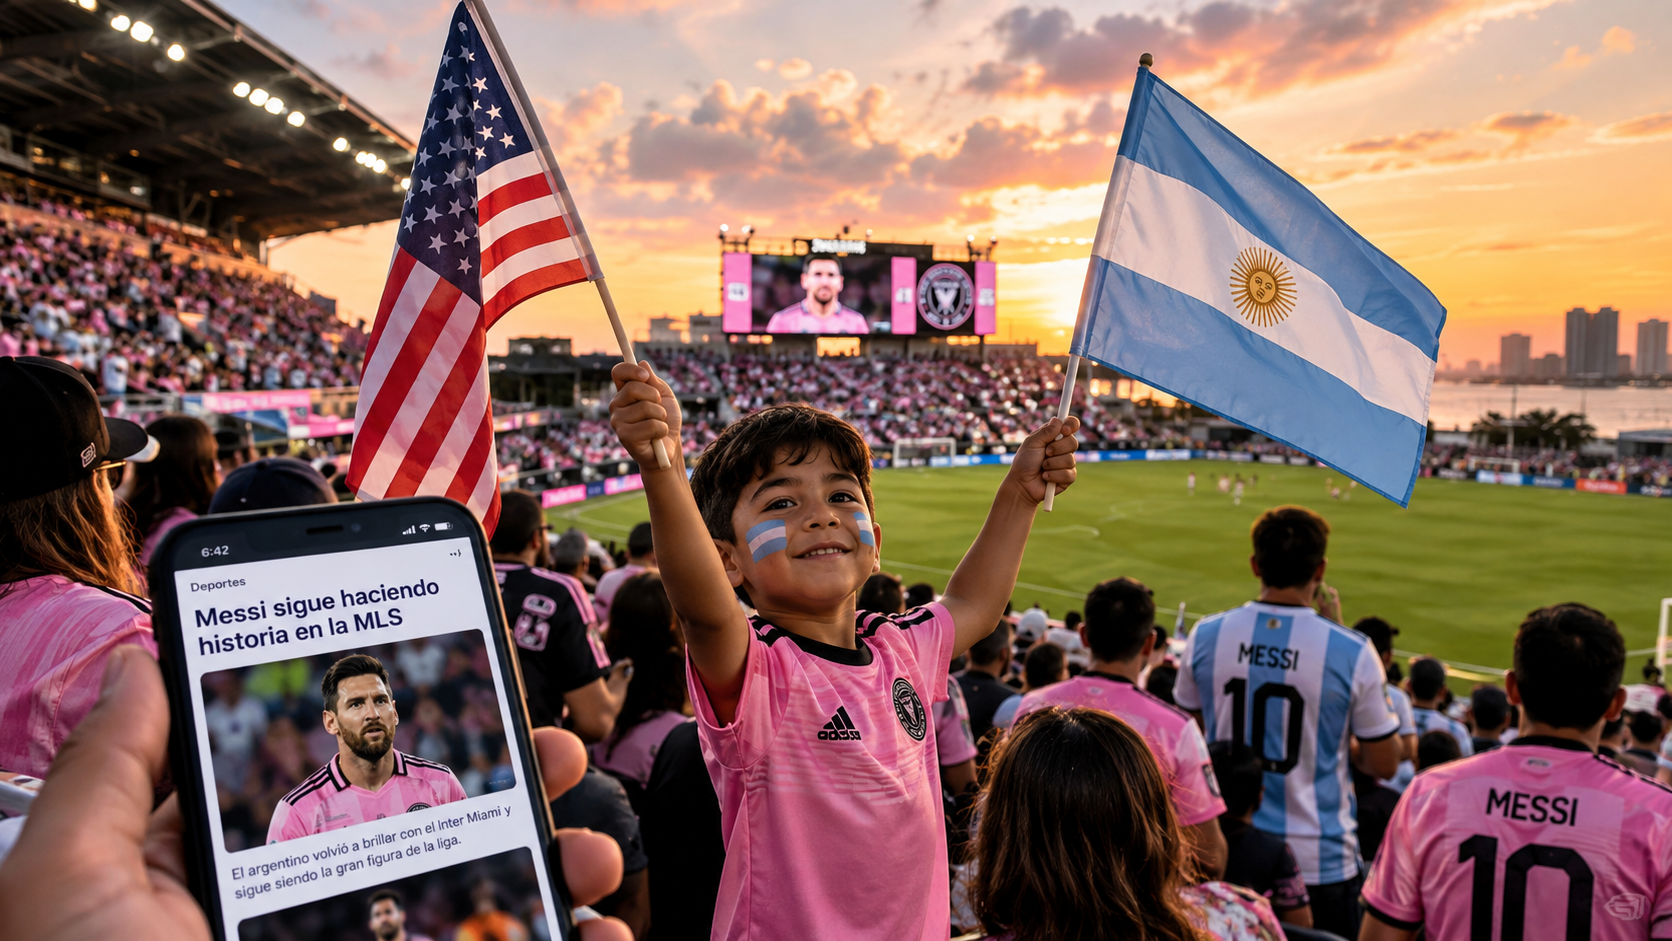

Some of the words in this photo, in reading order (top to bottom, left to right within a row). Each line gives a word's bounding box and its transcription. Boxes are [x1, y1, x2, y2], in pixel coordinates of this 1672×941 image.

[201, 545, 230, 558] 6:42
[190, 578, 247, 593] Deportes
[194, 600, 267, 628] Messi
[272, 596, 336, 619] sigue
[339, 578, 440, 608] haciendo
[198, 625, 290, 656] historia
[295, 624, 324, 641] en
[327, 617, 349, 636] la
[353, 607, 404, 632] MLS
[1238, 643, 1299, 671] MESSI
[1224, 677, 1305, 775] 10
[1485, 787, 1579, 827] MESSI
[231, 866, 245, 881] El
[248, 853, 310, 876] argentino
[312, 842, 349, 861] volvió
[352, 842, 360, 852] a
[362, 832, 397, 849] brillar
[399, 827, 423, 840] con
[424, 821, 436, 834] el
[437, 816, 464, 831] Inter
[466, 807, 502, 824] Miami
[504, 805, 511, 817] y
[235, 884, 271, 900] sigue
[275, 870, 318, 890] siendo
[320, 866, 333, 878] la
[335, 859, 364, 877] gran
[366, 850, 403, 868] figura
[405, 845, 421, 857] de
[423, 841, 435, 853] la
[436, 836, 462, 850] liga.
[1458, 834, 1595, 941] 10
